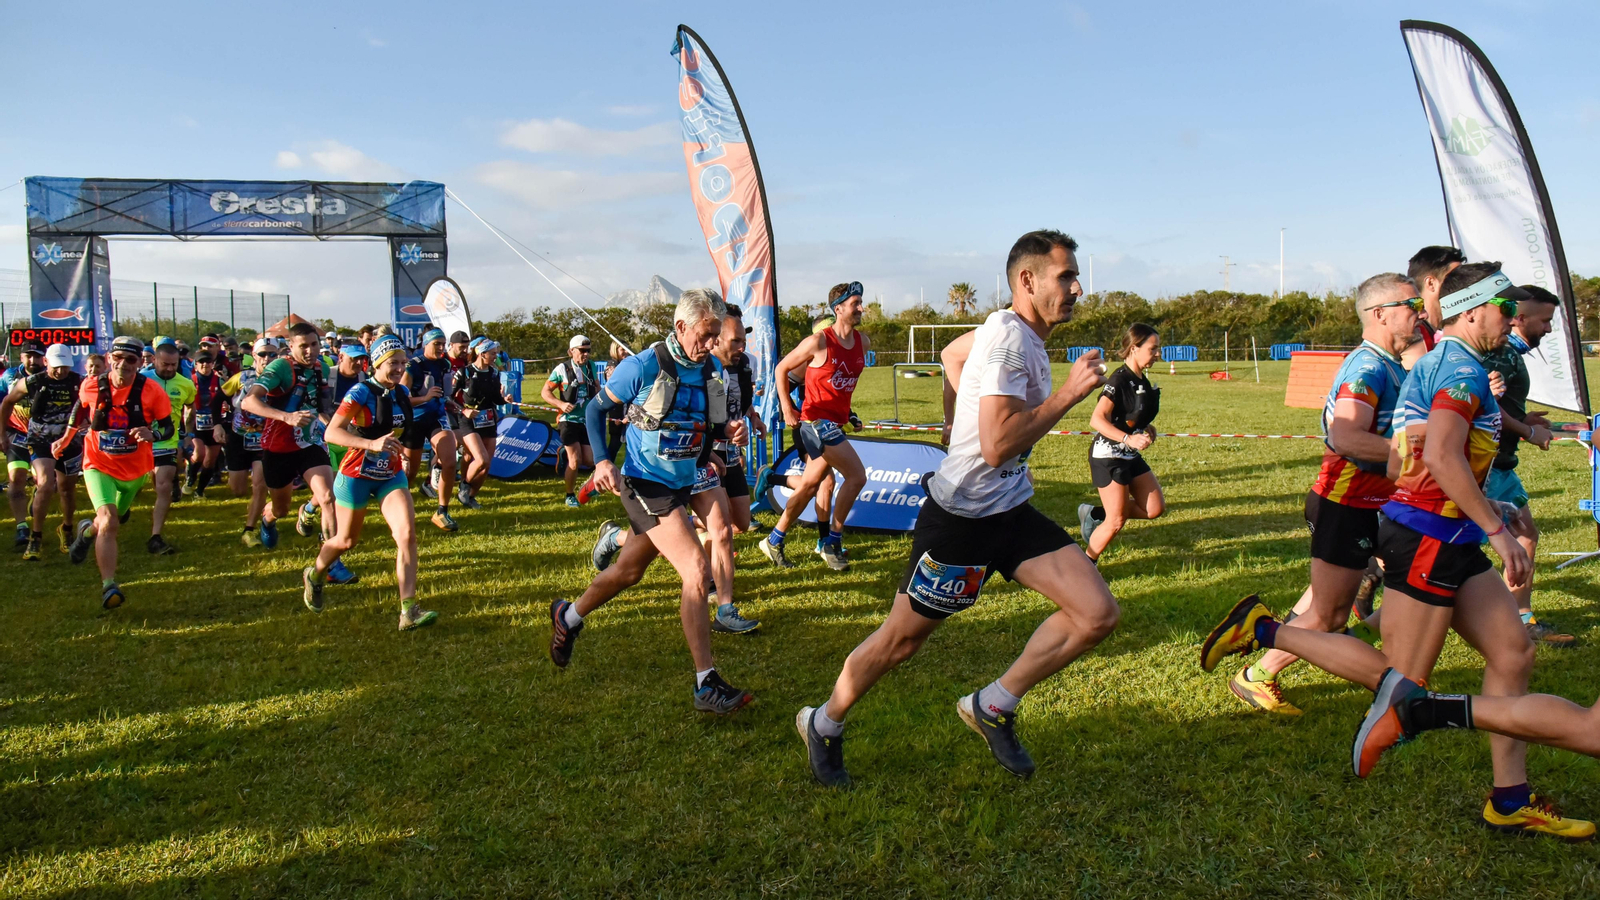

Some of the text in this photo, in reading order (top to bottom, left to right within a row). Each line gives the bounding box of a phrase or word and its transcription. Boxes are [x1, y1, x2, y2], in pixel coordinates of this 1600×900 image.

[414, 250, 439, 259] Línea
[111, 436, 126, 445] 76
[678, 433, 693, 445] 77
[376, 459, 389, 469] 65
[930, 576, 966, 595] 140
[917, 585, 955, 604] Carbonera
